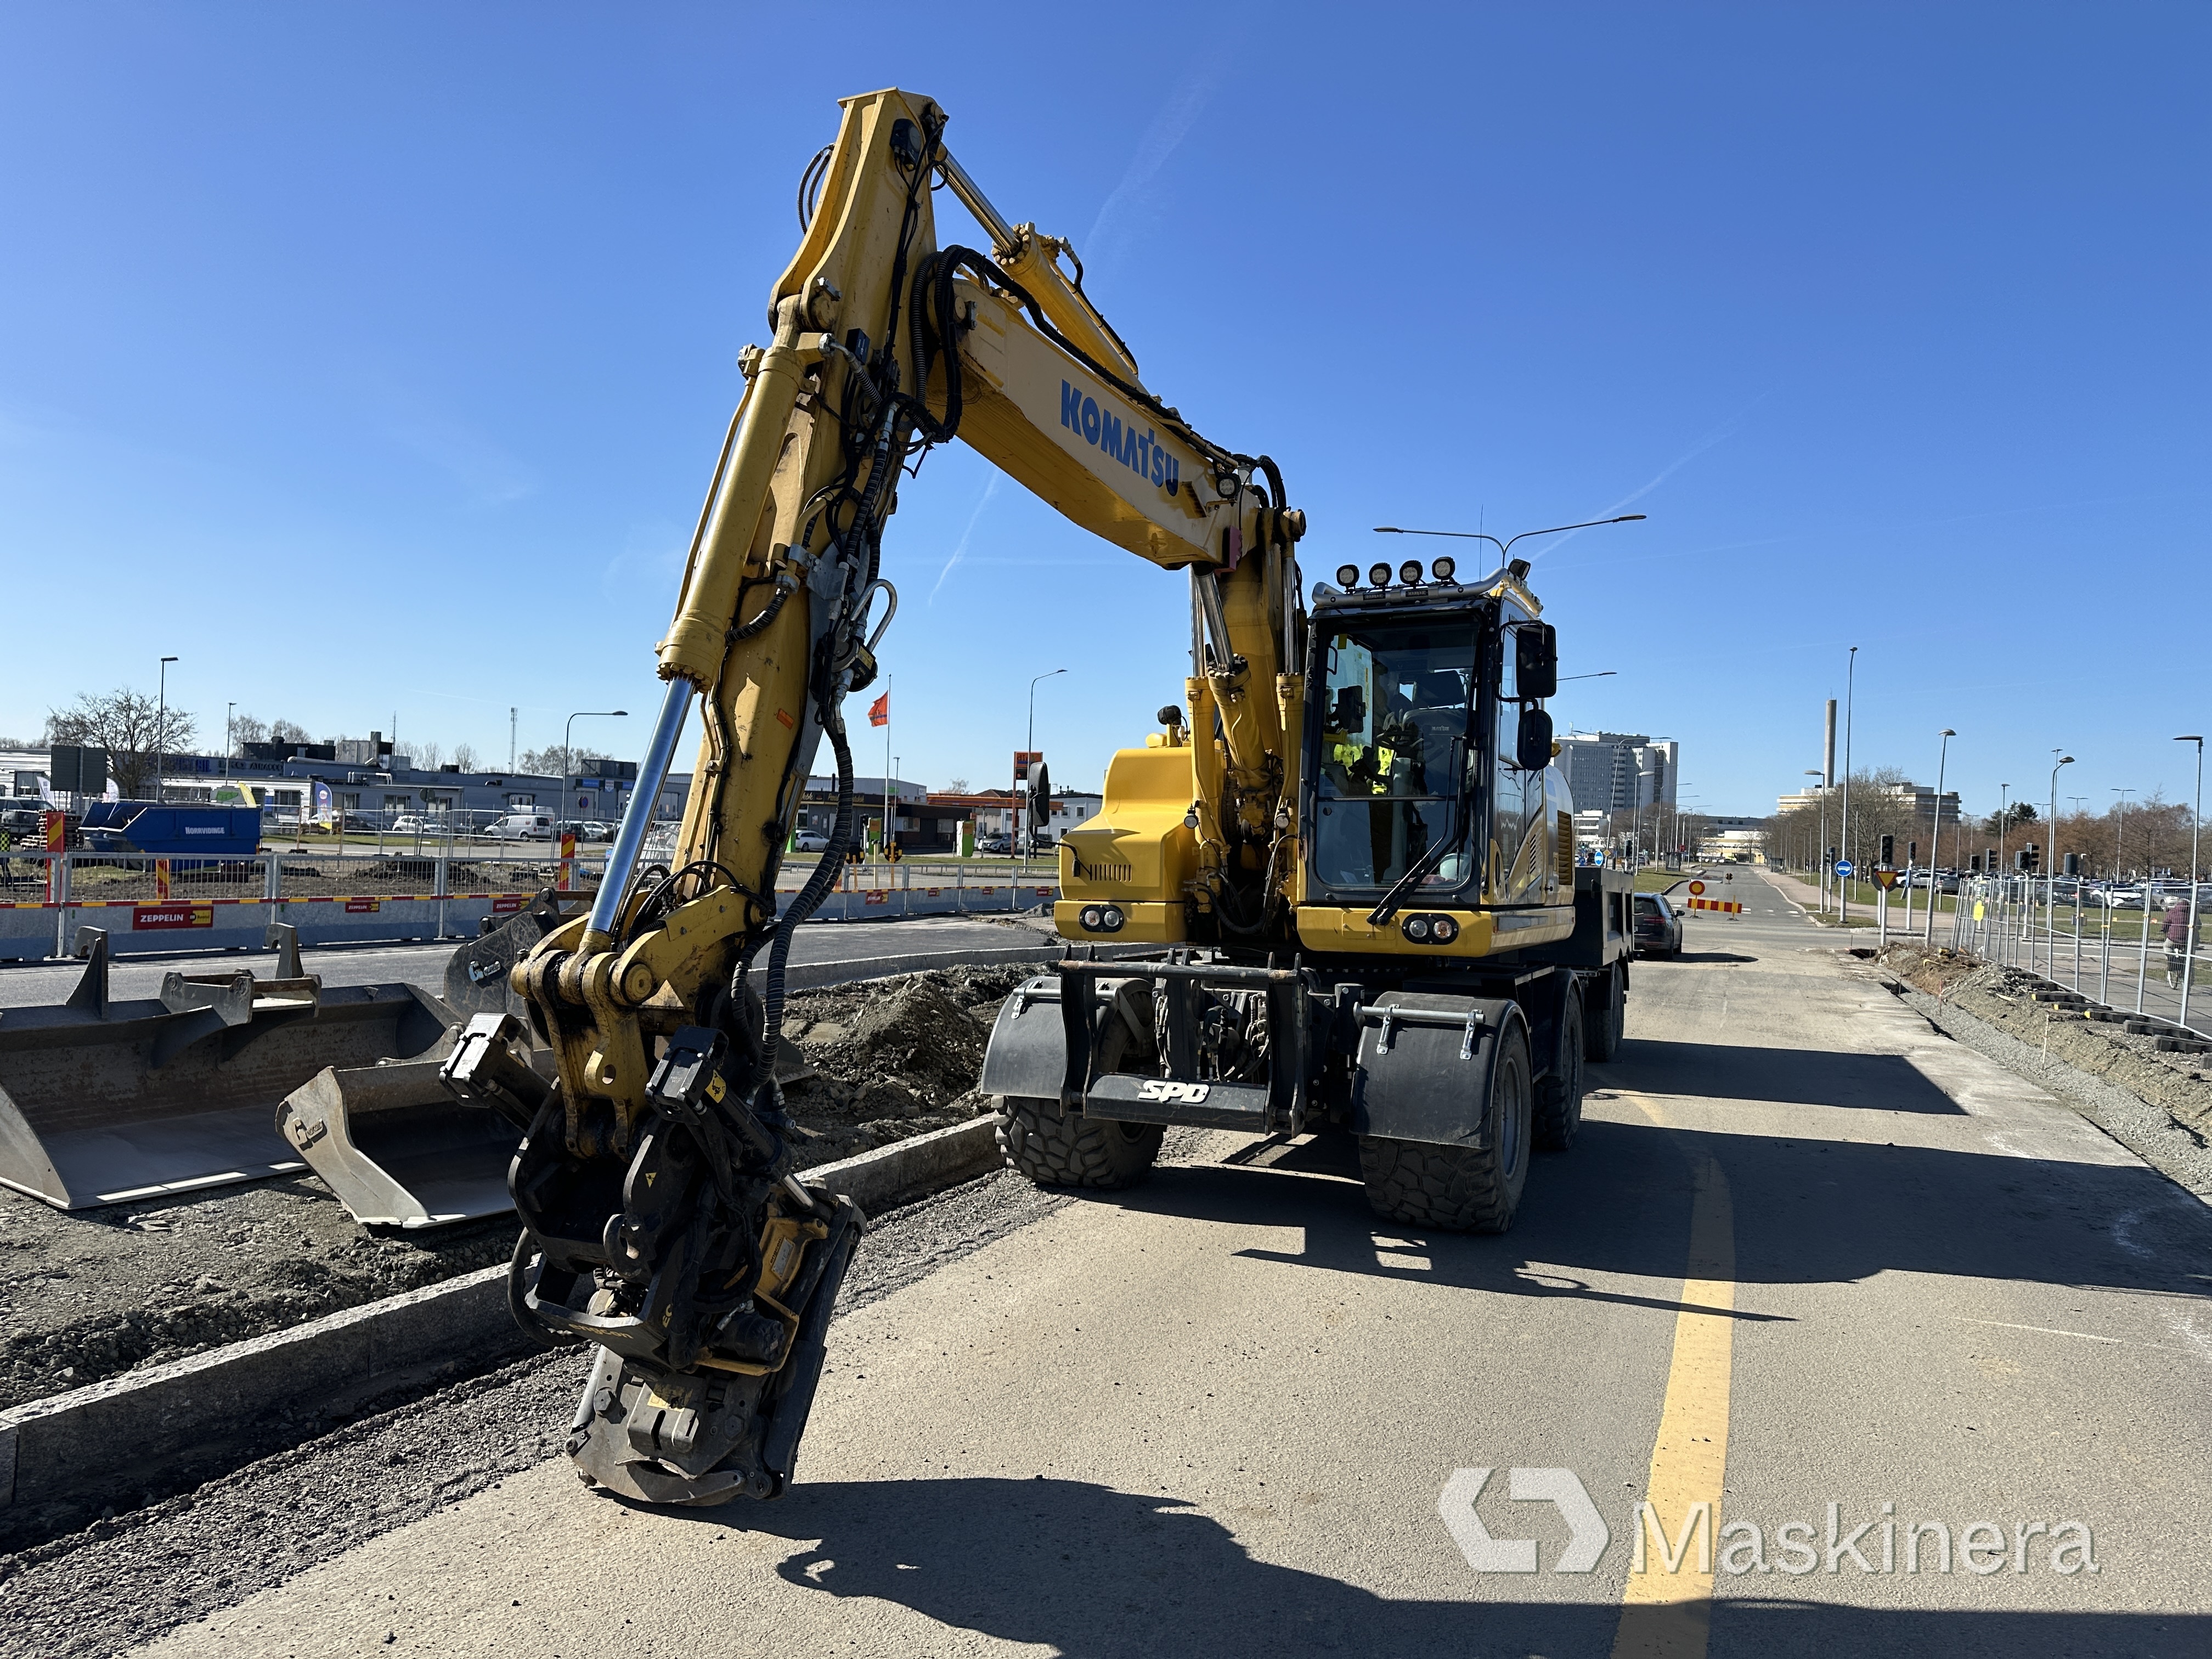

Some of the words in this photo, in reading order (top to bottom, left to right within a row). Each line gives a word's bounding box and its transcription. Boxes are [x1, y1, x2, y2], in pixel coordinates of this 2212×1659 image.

[1061, 379, 1179, 496] KOMATSU
[140, 913, 184, 923] ZEPPELIN
[1137, 1080, 1211, 1104] SPD
[568, 1323, 634, 1339] engcon
